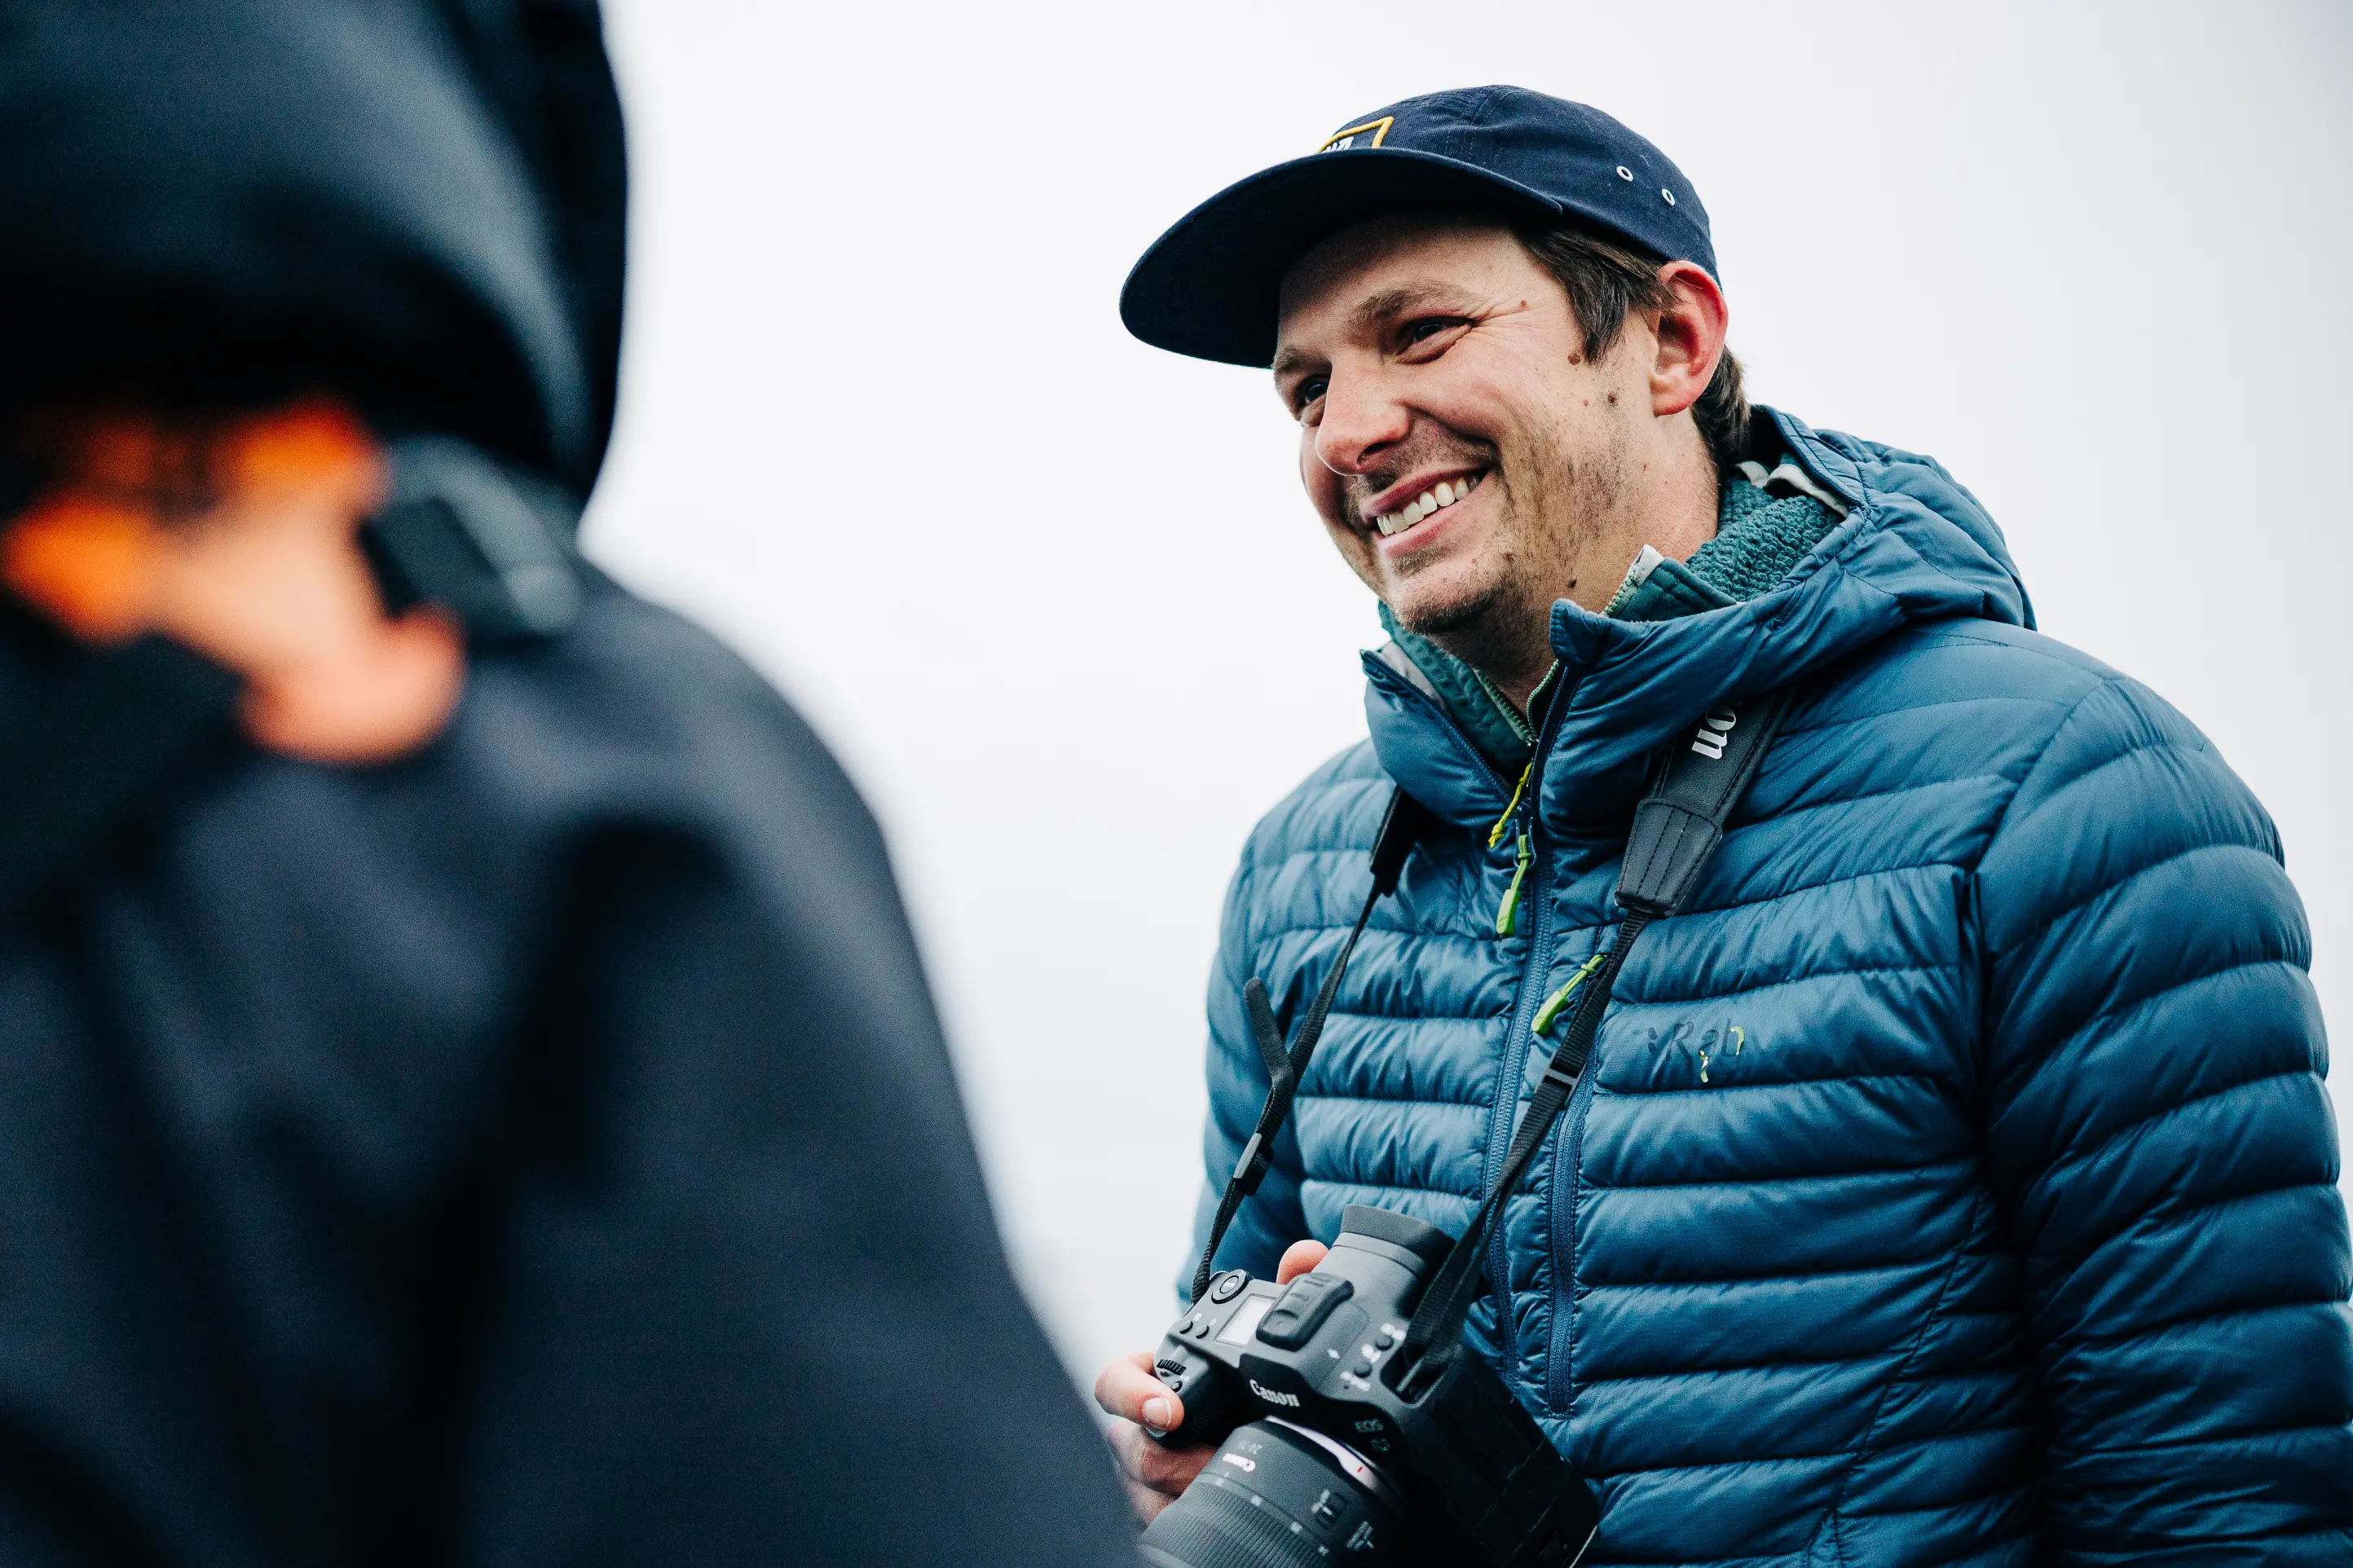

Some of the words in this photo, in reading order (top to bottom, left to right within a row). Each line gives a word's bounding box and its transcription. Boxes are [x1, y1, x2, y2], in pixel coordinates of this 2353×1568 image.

[1691, 706, 1737, 760] on
[1665, 1019, 1745, 1068] Rab
[1249, 1379, 1300, 1407] Canon
